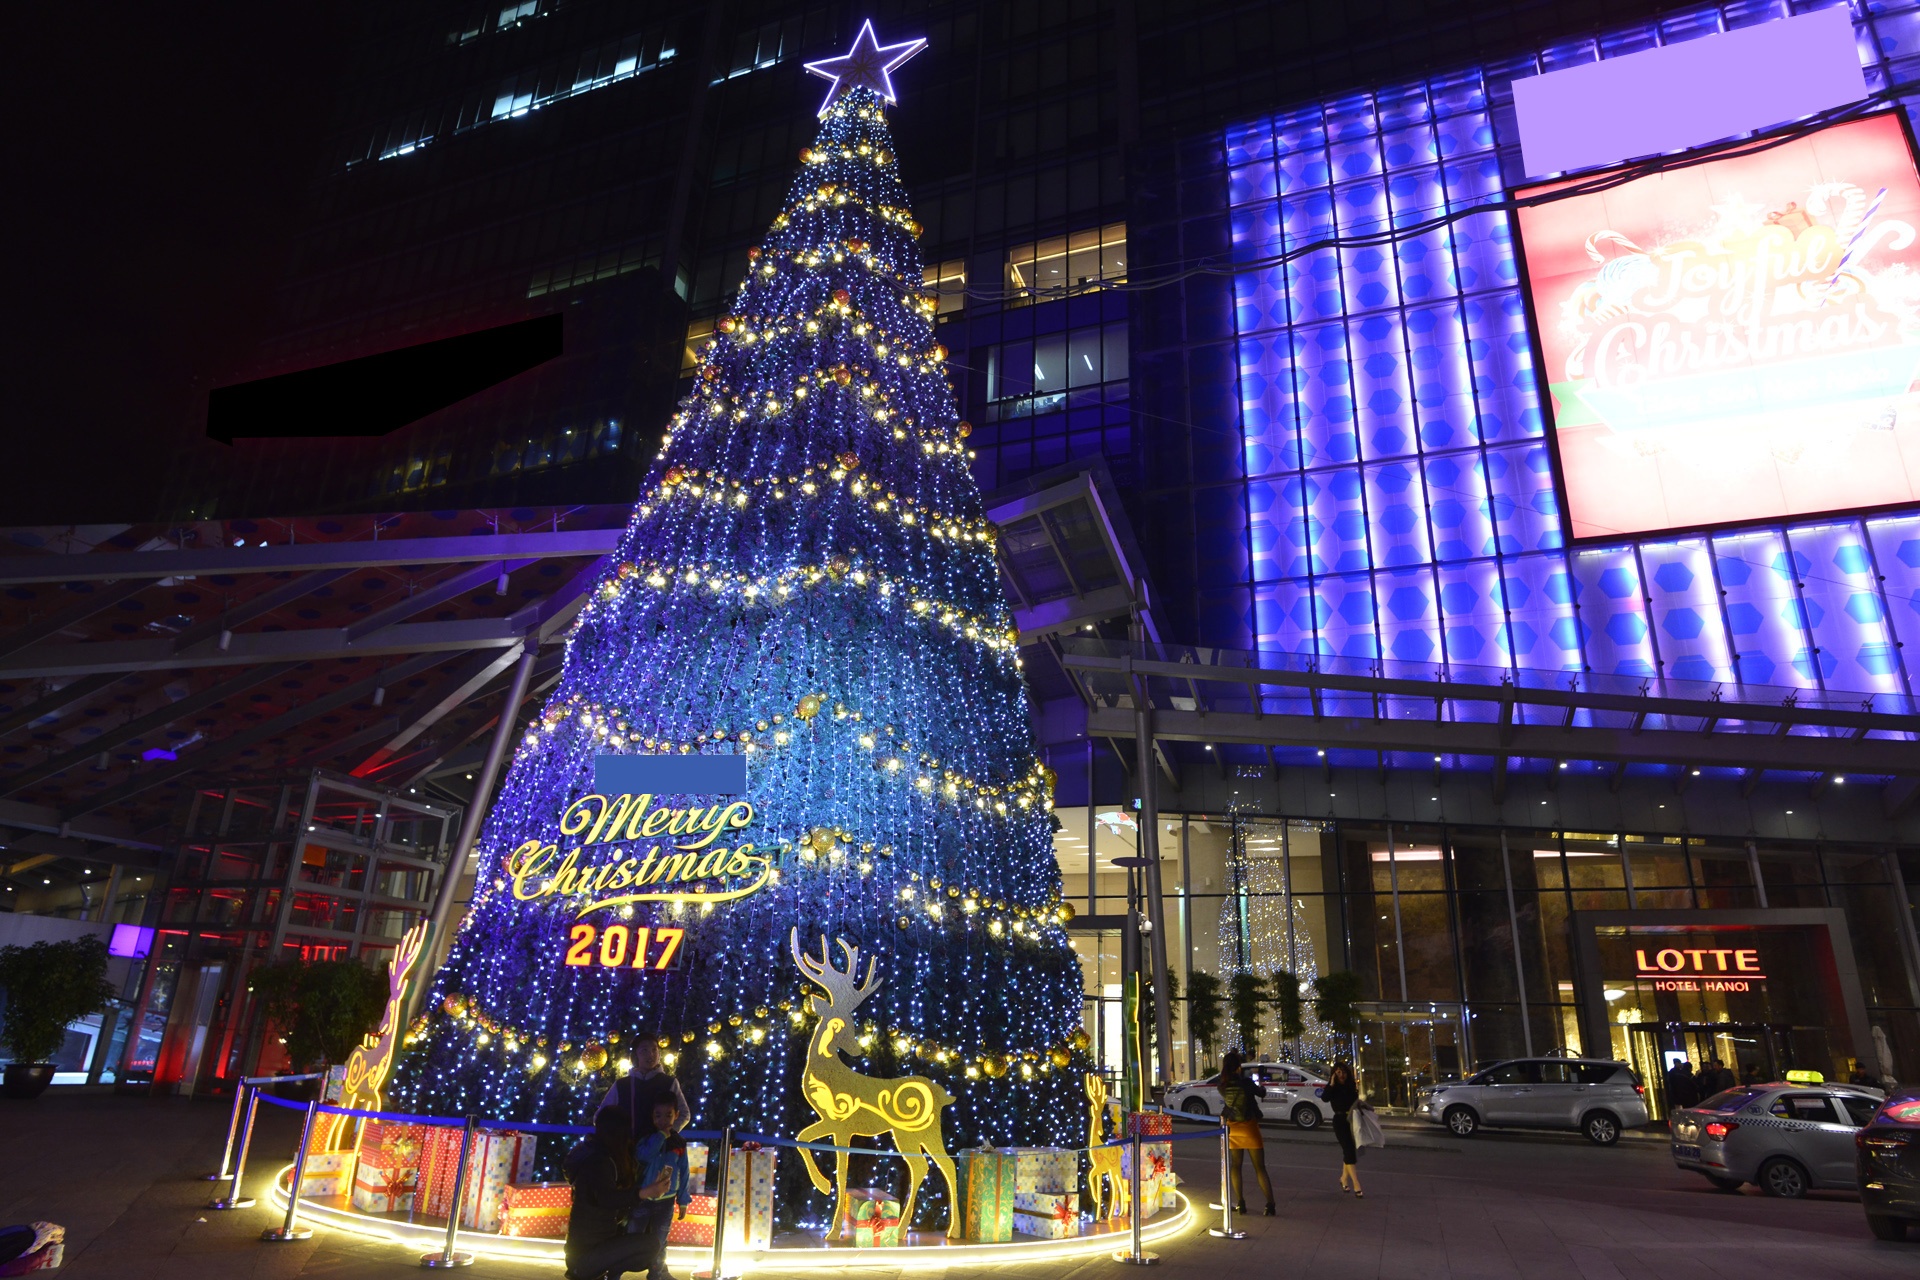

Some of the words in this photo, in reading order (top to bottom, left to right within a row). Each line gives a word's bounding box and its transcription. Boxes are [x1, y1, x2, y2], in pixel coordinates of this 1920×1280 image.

[1645, 231, 1833, 322] Joyful
[1595, 303, 1888, 389] Christmas
[560, 794, 753, 849] Merry
[509, 839, 770, 919] Christmas
[565, 925, 684, 969] 2017
[1636, 949, 1760, 971] LOTTE
[1655, 981, 1700, 992] HOTEL
[1705, 981, 1749, 992] HANOI
